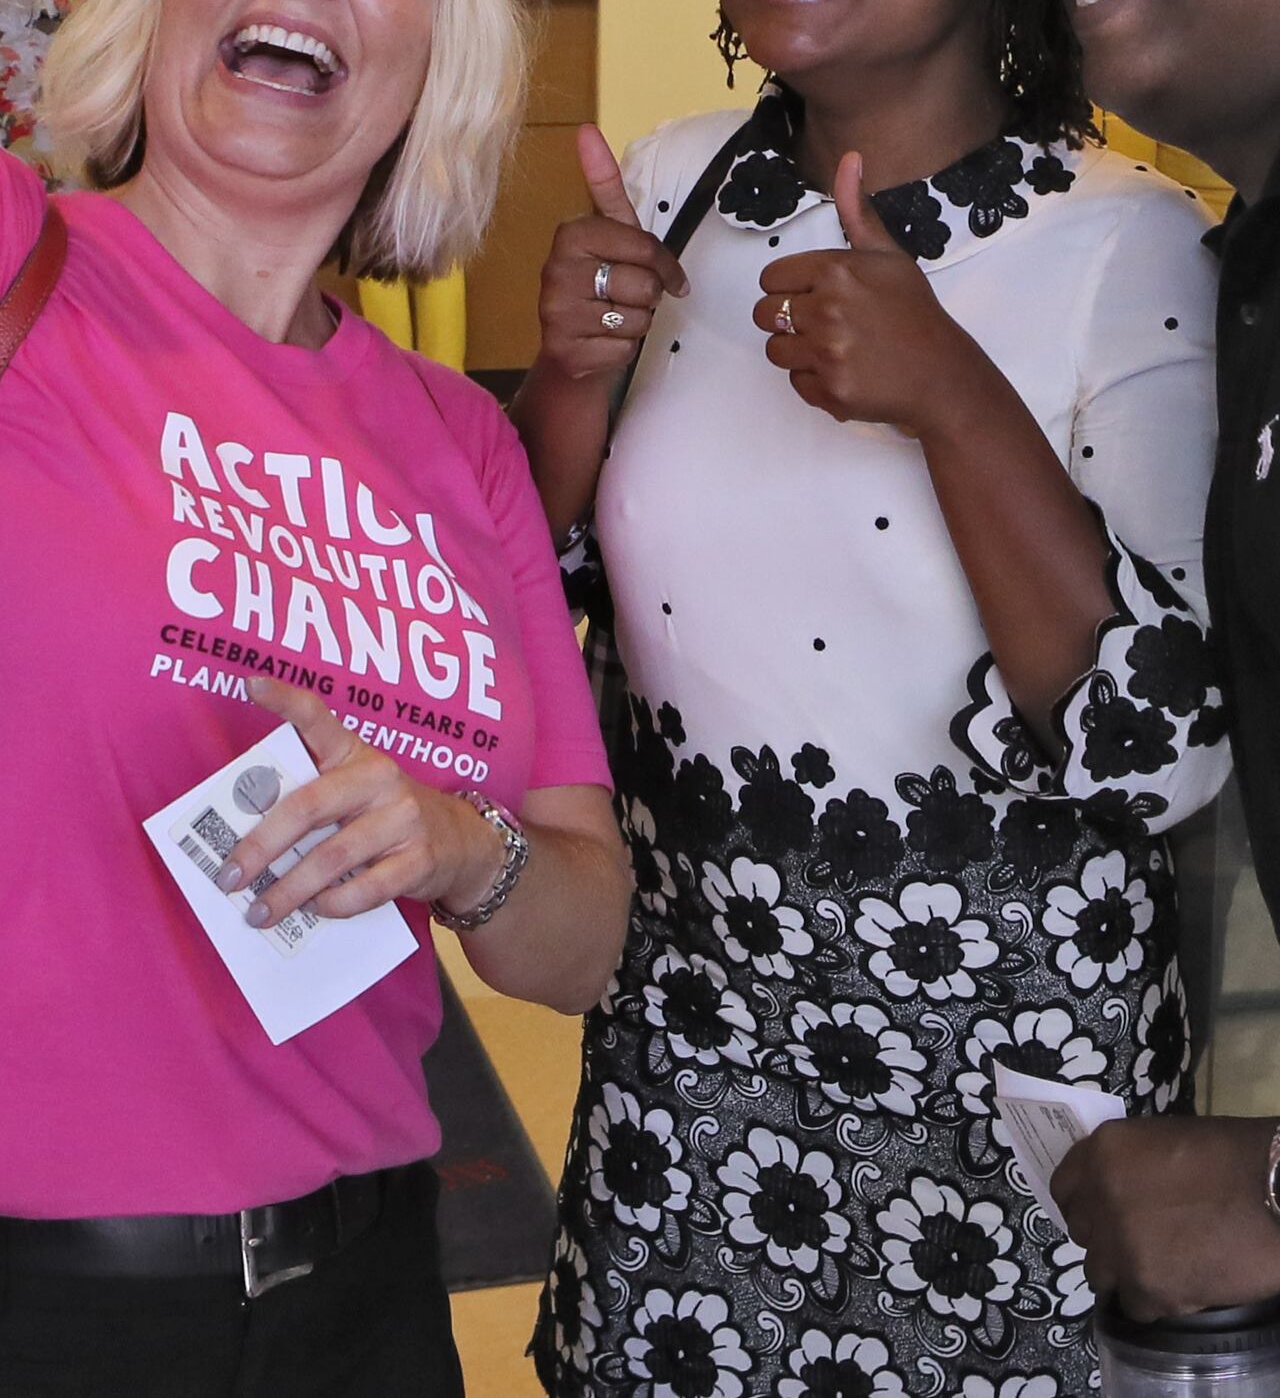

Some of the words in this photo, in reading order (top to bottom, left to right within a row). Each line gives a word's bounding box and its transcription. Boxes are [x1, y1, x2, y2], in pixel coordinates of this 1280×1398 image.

[161, 624, 334, 696] CELEBRATING
[347, 685, 384, 711] 100
[395, 699, 466, 739] YEARS
[473, 729, 499, 752] OF
[166, 537, 503, 721] CHANGE
